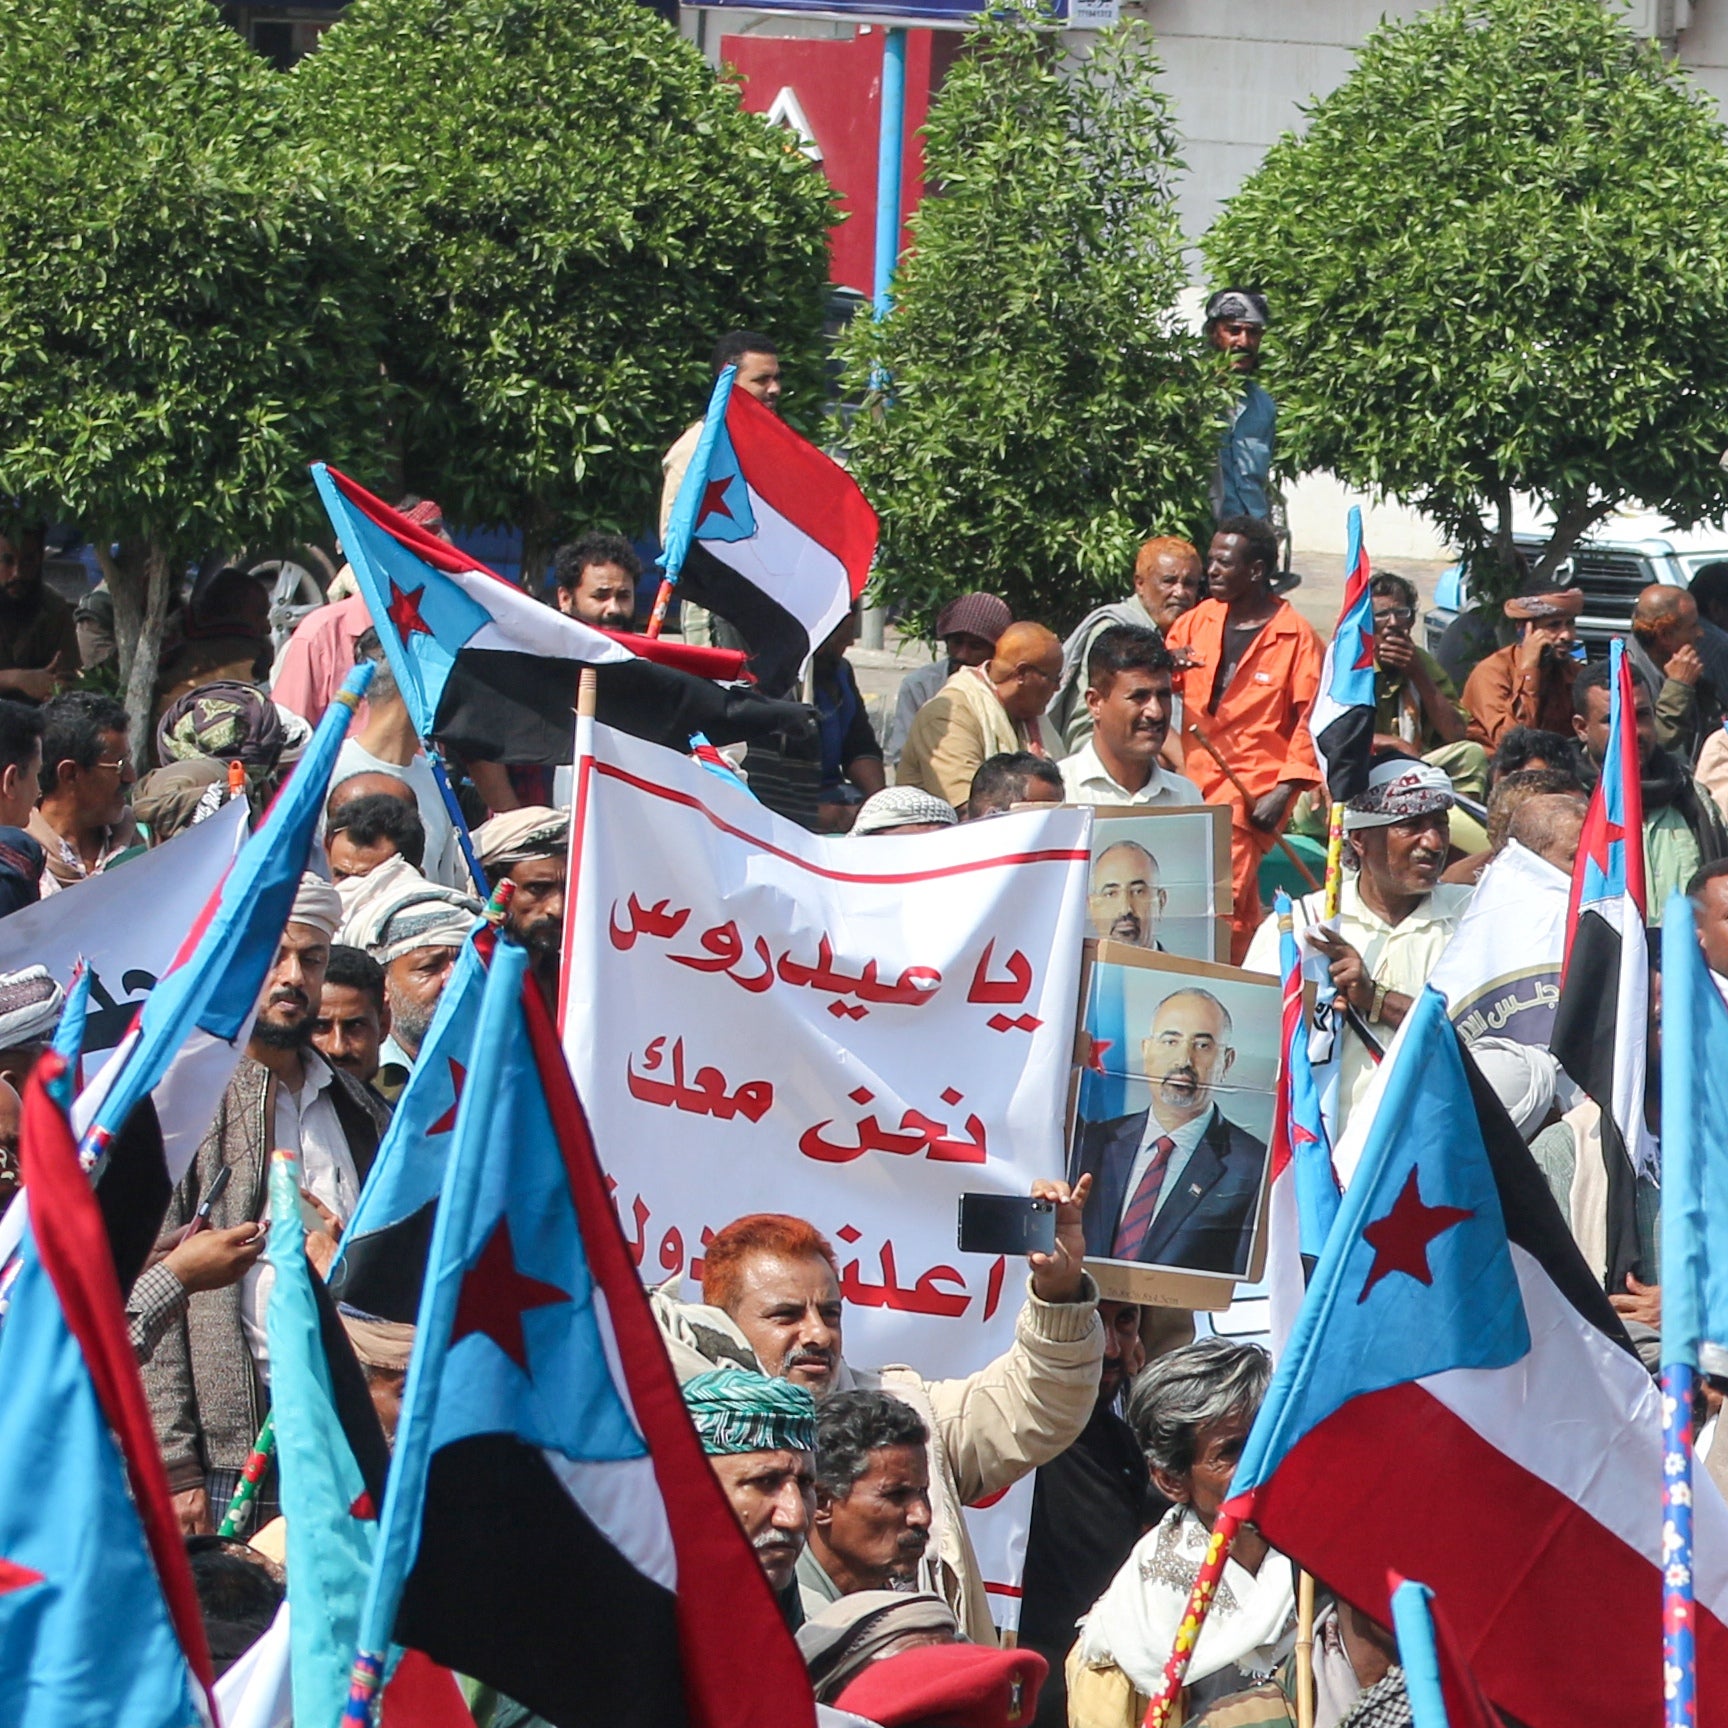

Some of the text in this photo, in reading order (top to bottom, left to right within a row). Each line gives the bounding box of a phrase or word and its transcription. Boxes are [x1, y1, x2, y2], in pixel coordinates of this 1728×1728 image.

[608, 890, 1043, 1032] يا عيدروس
[626, 1034, 987, 1165] نحن معك
